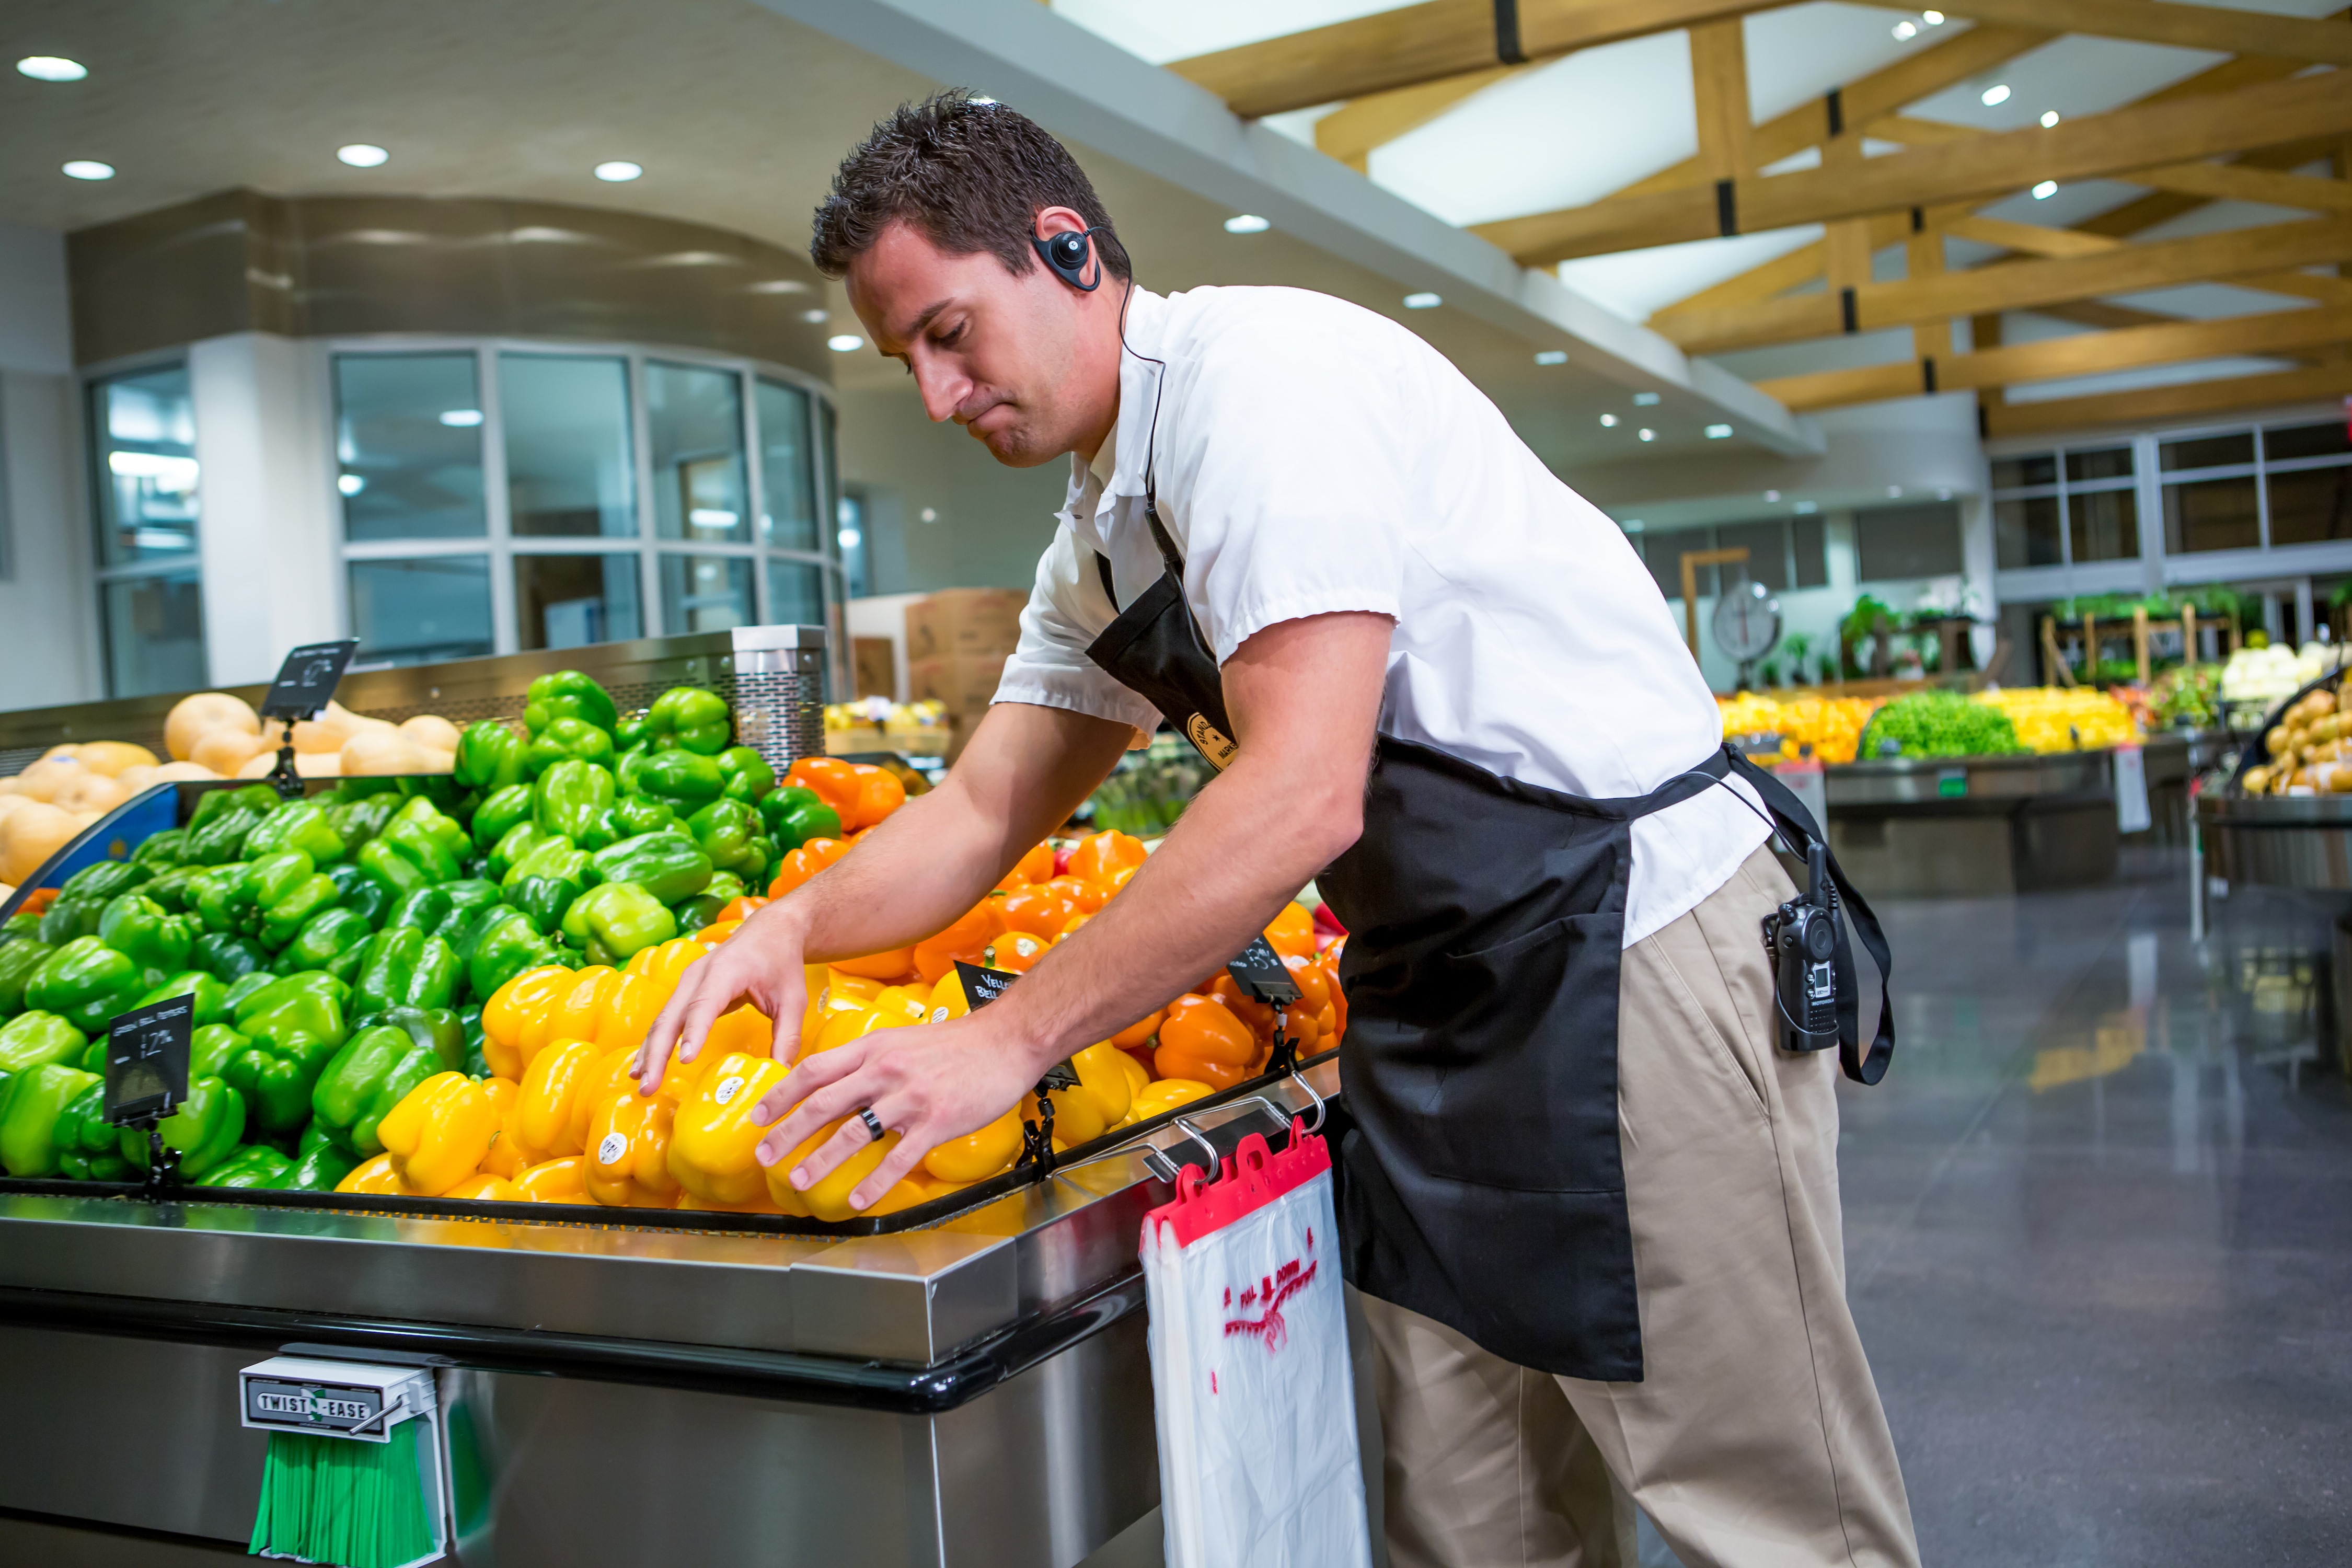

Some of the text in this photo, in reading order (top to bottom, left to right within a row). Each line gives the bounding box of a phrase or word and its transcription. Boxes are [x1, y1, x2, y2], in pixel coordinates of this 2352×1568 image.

[975, 986, 999, 999] BELL
[1240, 1258, 1299, 1309] PULL DOWN
